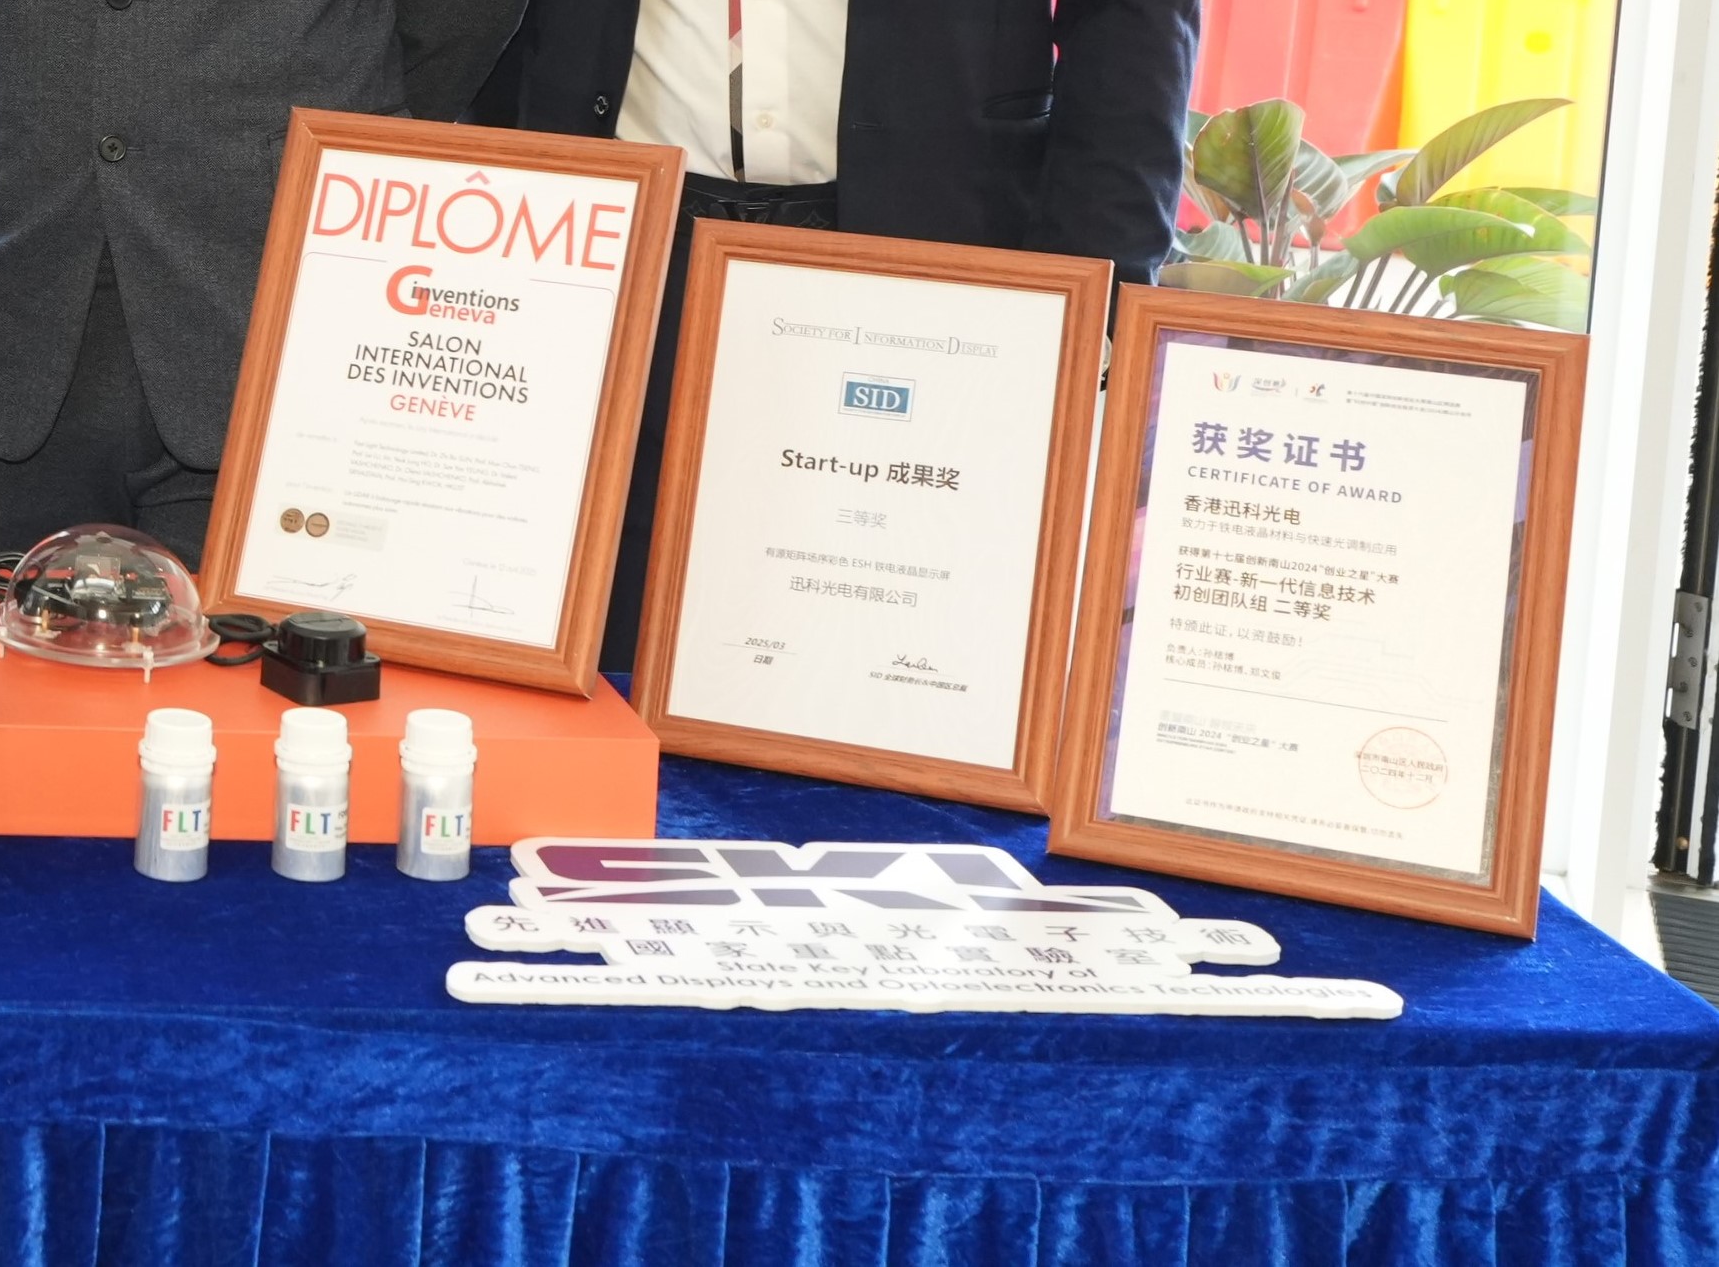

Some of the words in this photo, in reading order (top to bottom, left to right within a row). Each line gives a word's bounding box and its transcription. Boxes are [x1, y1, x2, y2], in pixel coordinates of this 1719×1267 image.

[311, 170, 625, 271] DIPLÔME
[386, 265, 496, 325] Geneva
[411, 281, 520, 312] inventions
[408, 331, 482, 356] SALON
[355, 344, 527, 383] INTERNATIONAL
[347, 364, 385, 384] DES
[392, 369, 529, 404] INVENTIONS
[853, 386, 901, 410] SID
[390, 394, 476, 421] GENÈVE
[1192, 422, 1366, 472] 获奖证书
[781, 449, 879, 482] Start-up
[886, 462, 961, 491] 成果奖
[1188, 466, 1301, 491] CERTIFICATE
[1308, 481, 1331, 494] OF
[1337, 485, 1402, 503] AWARD
[836, 508, 887, 529] 三等奖
[1184, 495, 1301, 526] 香港迅科光电
[852, 558, 872, 568] ESH
[875, 561, 951, 581] 铁电液晶显示屏
[1176, 562, 1376, 605] 行业赛-新一代信息技术
[789, 576, 918, 607] 迅科光电有限公司
[1173, 584, 1268, 613] 初创团队组
[1273, 599, 1331, 621] 二等奖
[745, 637, 786, 650] 2025/03
[753, 655, 773, 665] 日期
[162, 810, 201, 833] FLT
[290, 810, 331, 835] FLT
[425, 814, 464, 837] FLT
[536, 846, 1152, 913] SKL
[493, 915, 1253, 946] 先進顯示與光電子技術
[625, 939, 1162, 965] 國家重點實驗室
[717, 960, 798, 975] State
[809, 961, 869, 978] Key
[881, 962, 1055, 980] Laboratory
[1068, 966, 1099, 978] of
[474, 971, 646, 987] Advanced
[657, 973, 792, 991] Displays
[803, 977, 867, 990] and
[879, 979, 1146, 997] Optoelectronics
[1150, 982, 1373, 1001] Technologies
